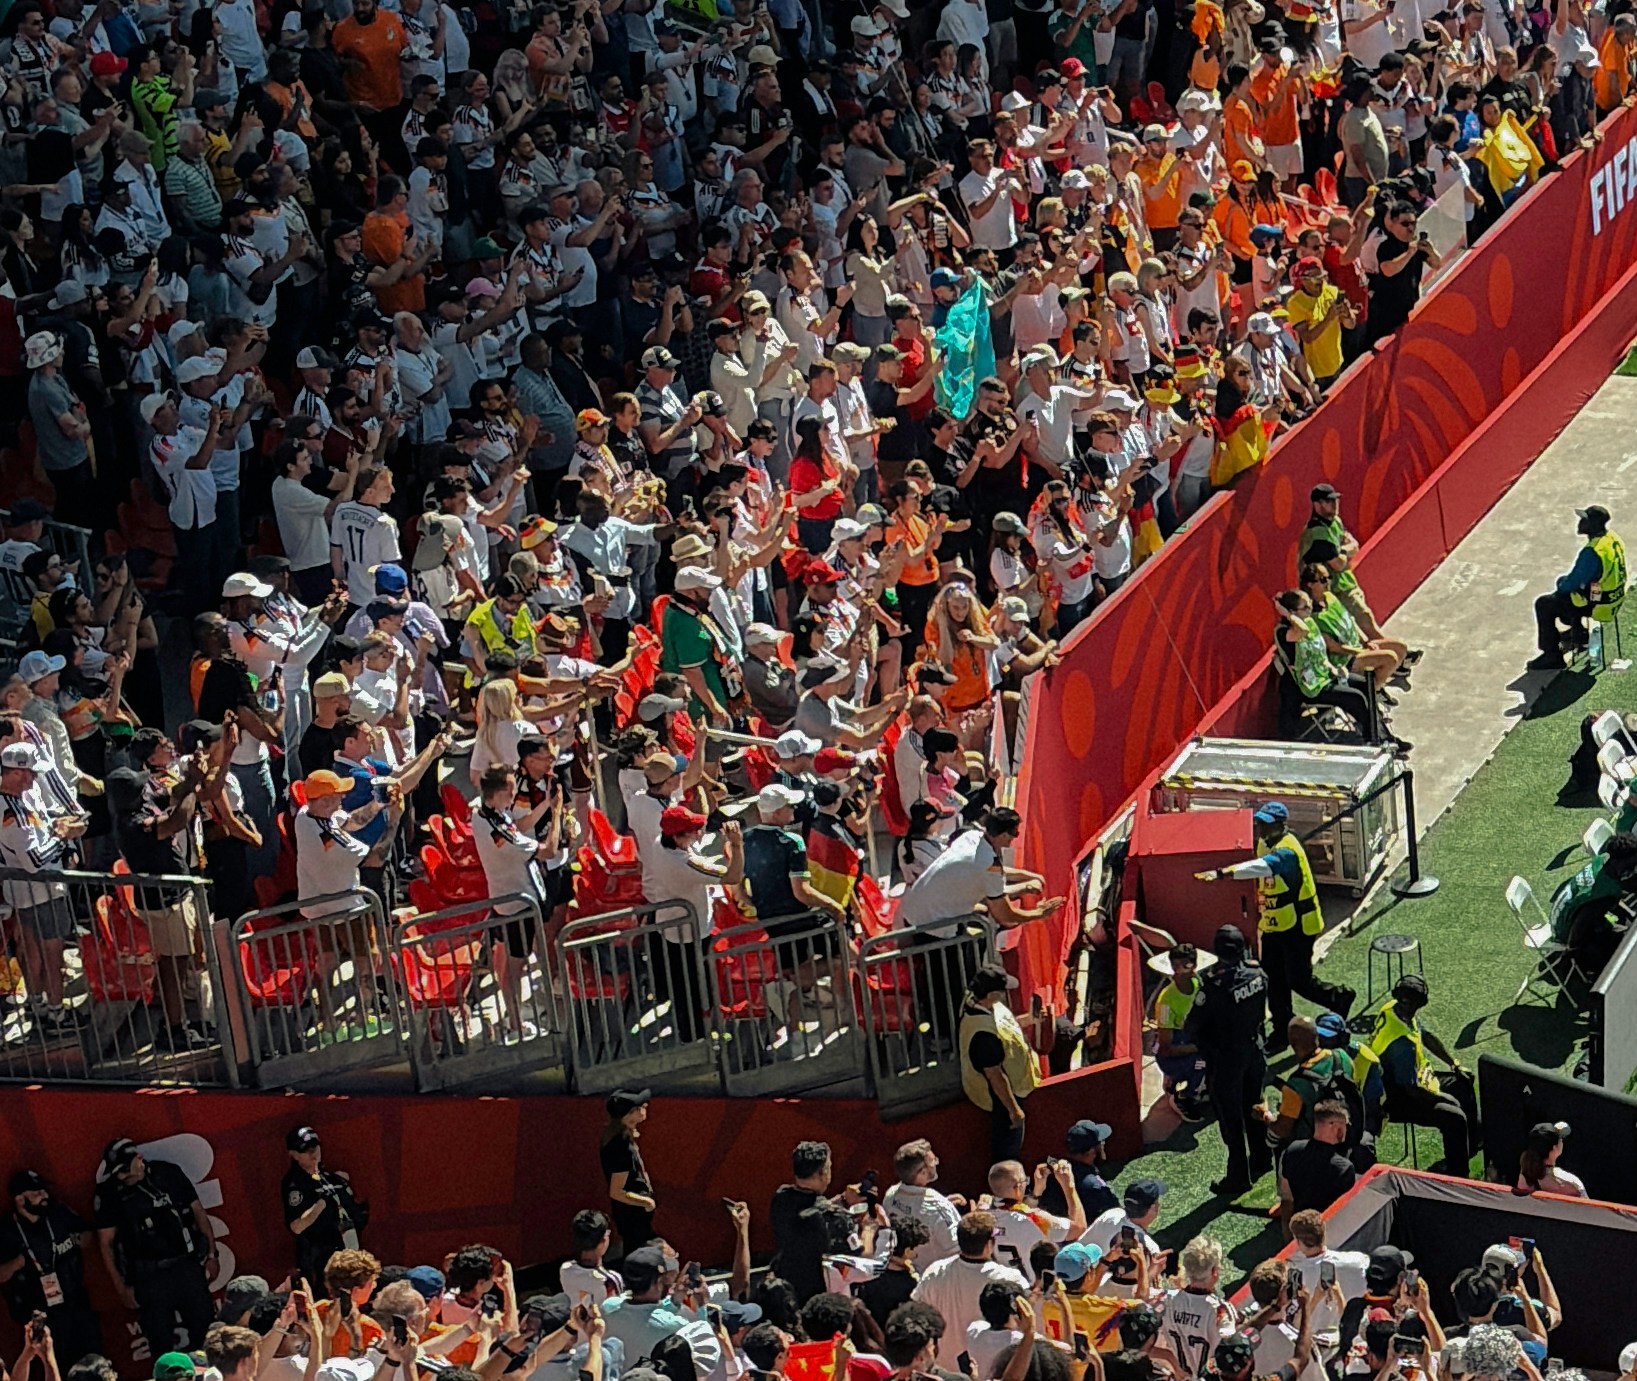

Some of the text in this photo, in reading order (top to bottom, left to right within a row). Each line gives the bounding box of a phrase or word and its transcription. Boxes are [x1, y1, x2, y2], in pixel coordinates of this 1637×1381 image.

[347, 525, 364, 563] 17
[1233, 976, 1265, 1003] POLICE
[1173, 1310, 1201, 1329] WIRTZ
[1169, 1330, 1209, 1377] 17
